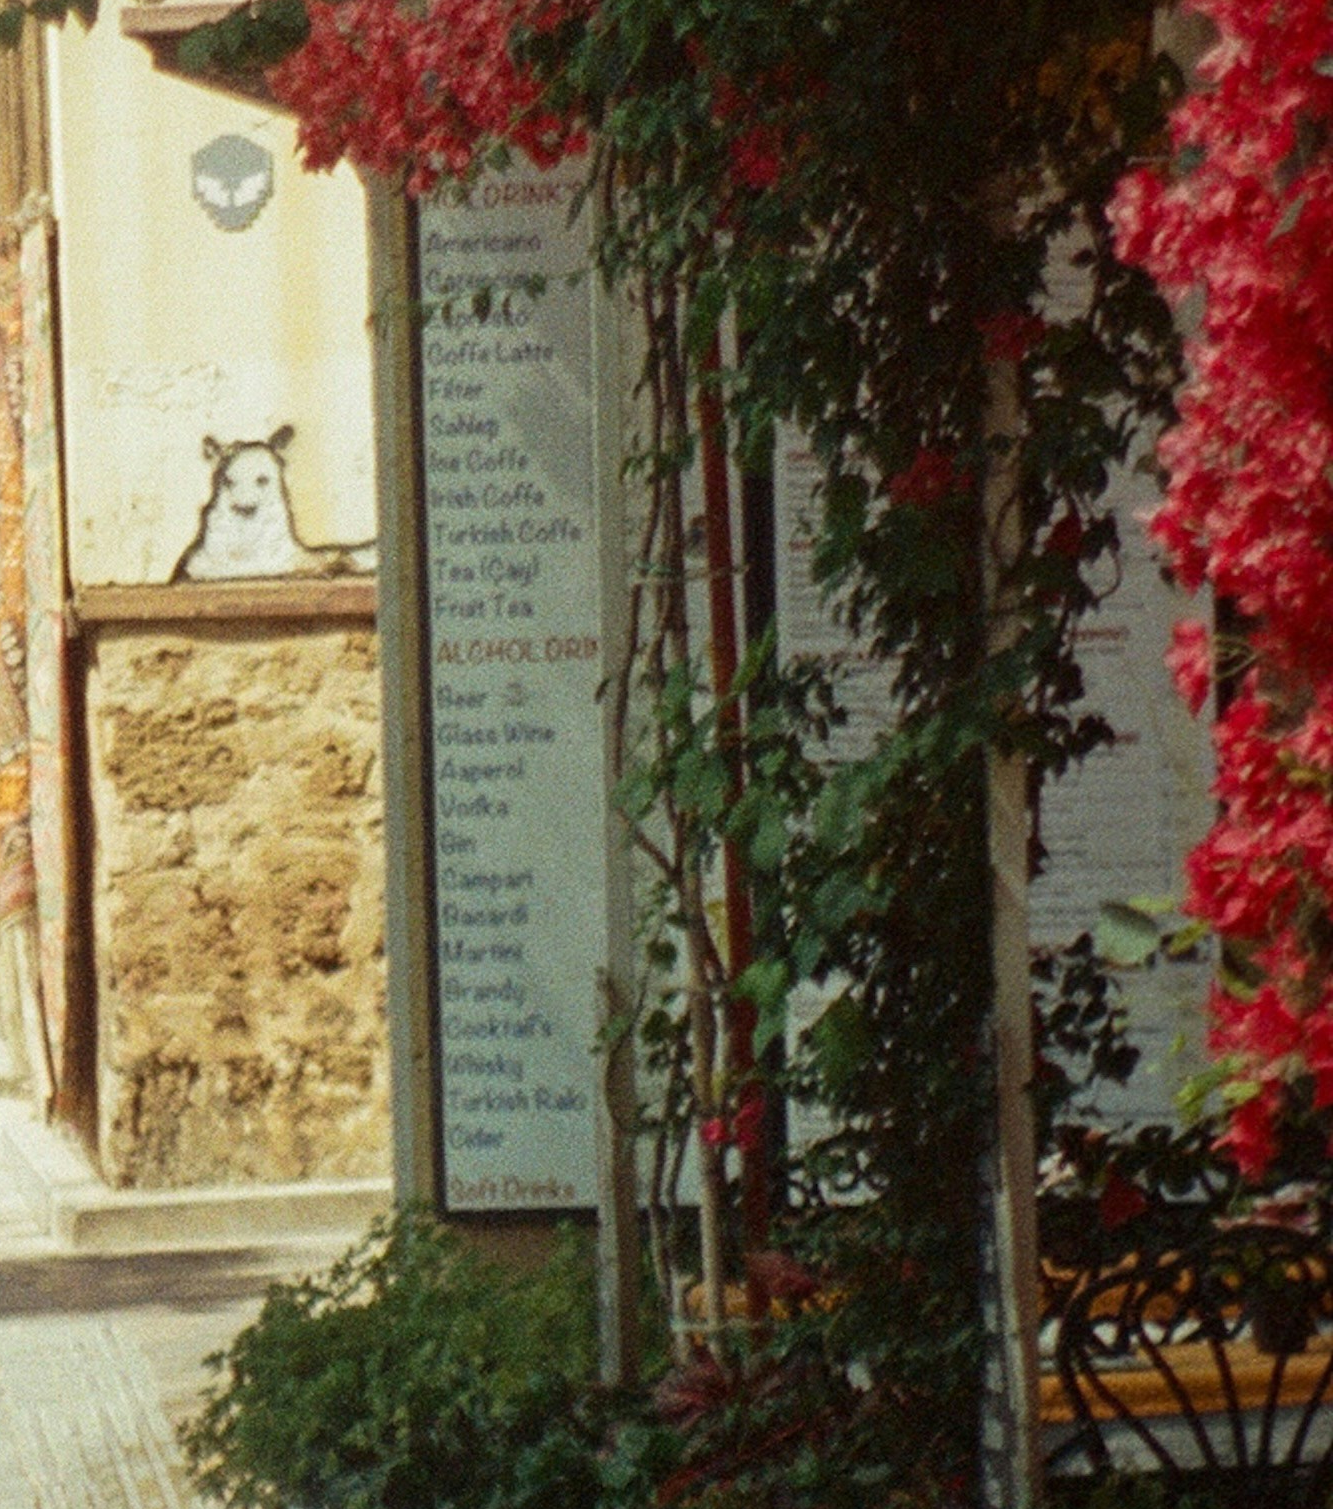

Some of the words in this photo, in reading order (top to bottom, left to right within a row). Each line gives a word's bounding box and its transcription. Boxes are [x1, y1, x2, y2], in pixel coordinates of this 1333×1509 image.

[496, 341, 554, 364] Latte
[434, 521, 513, 546] Turkish
[434, 557, 475, 582] Tea
[492, 592, 535, 618] Tea
[436, 684, 487, 708] Beer
[437, 722, 498, 746] Glass
[504, 721, 556, 744] Wine
[439, 793, 509, 819] Vodka
